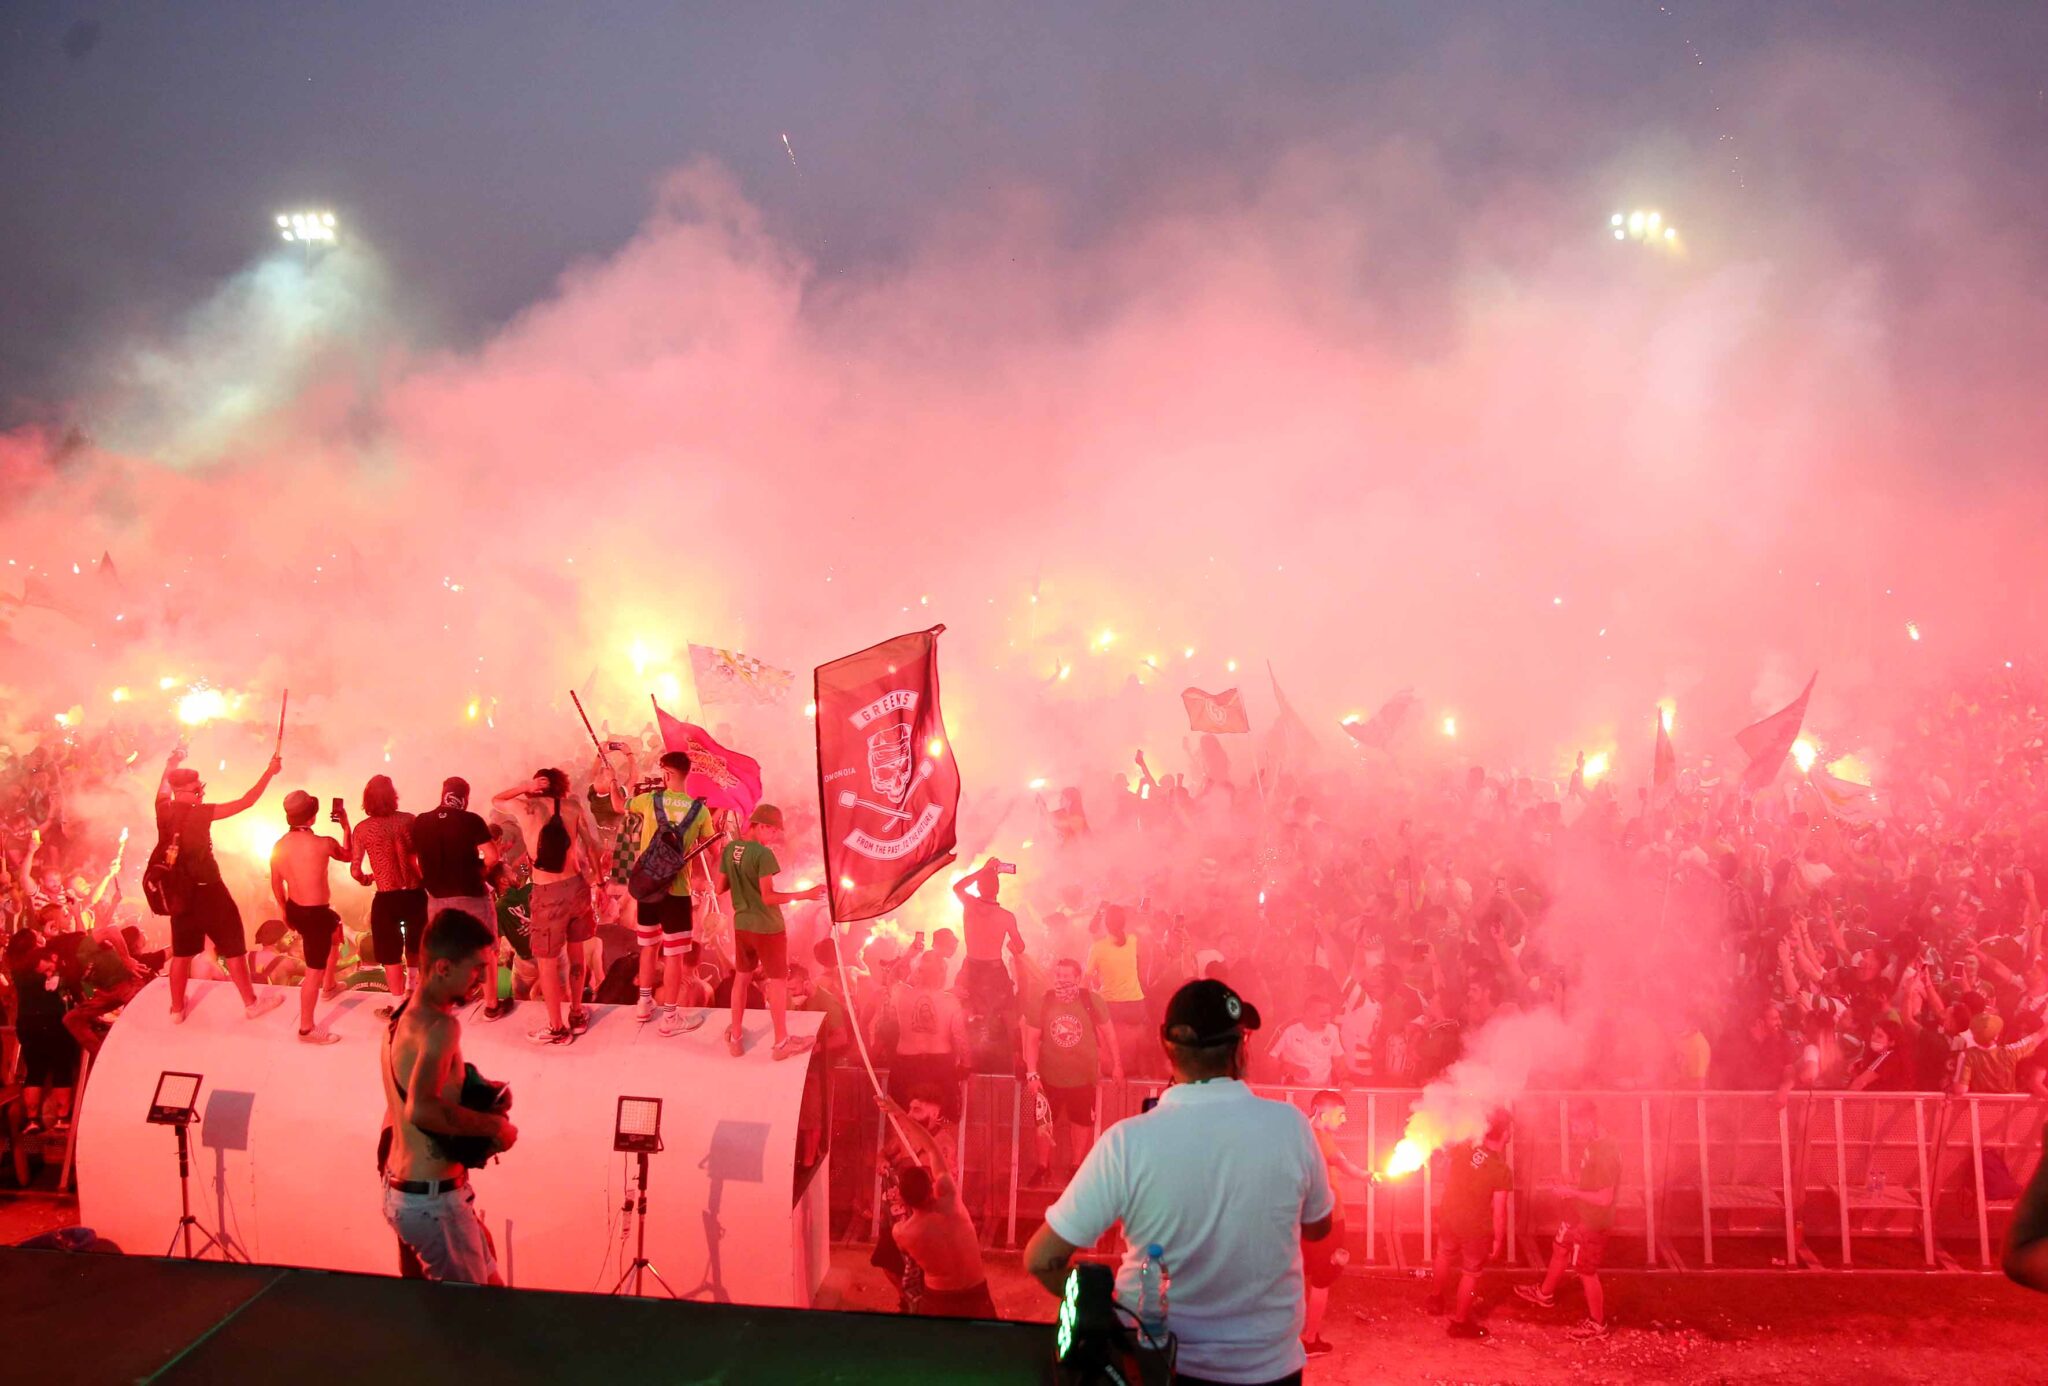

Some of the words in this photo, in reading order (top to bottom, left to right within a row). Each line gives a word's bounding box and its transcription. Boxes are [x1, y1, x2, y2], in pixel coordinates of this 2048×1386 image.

[861, 693, 910, 721] GREENS
[856, 836, 874, 851] FROM
[875, 844, 886, 855] THE
[887, 844, 900, 854] PAST
[908, 832, 919, 844] THE
[917, 812, 934, 835] FUTURE
